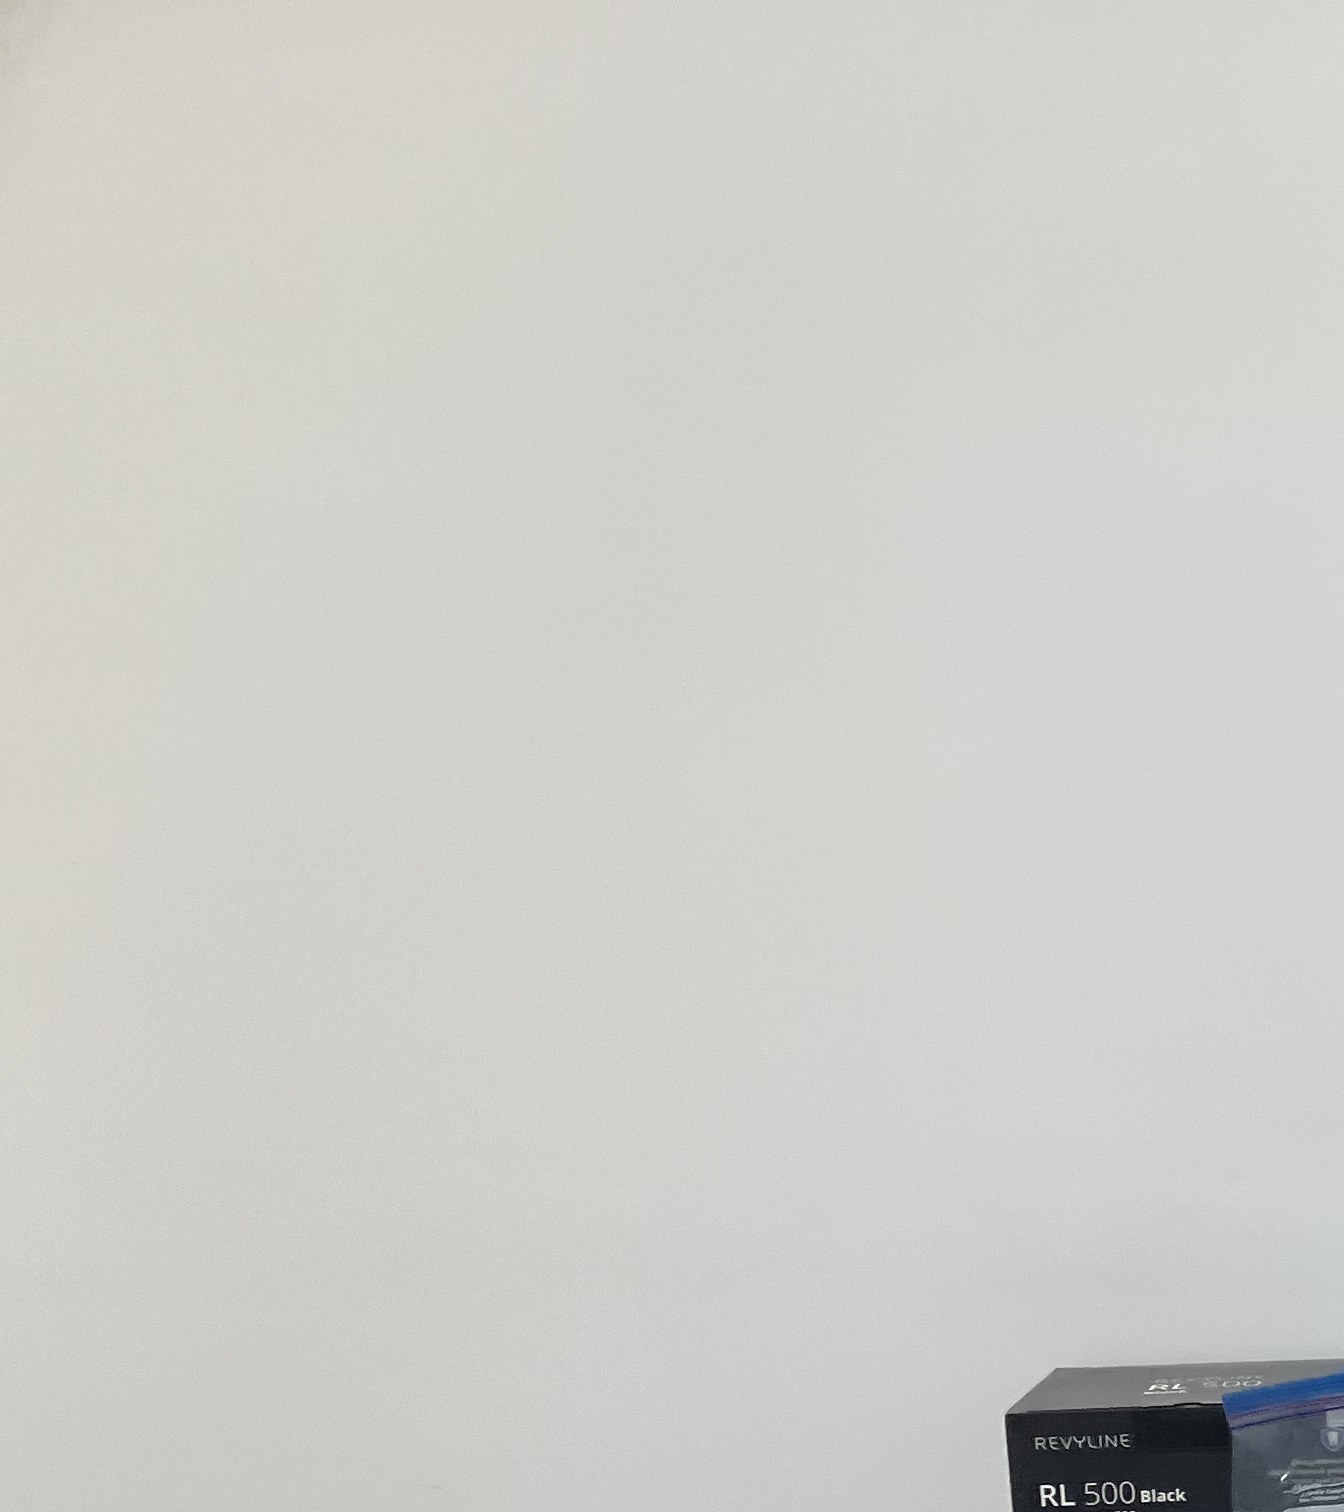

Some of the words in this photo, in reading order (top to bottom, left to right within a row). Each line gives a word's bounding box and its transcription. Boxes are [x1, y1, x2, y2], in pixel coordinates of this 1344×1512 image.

[1034, 1433, 1131, 1451] REVYLINE
[1039, 1483, 1076, 1508] RL
[1083, 1480, 1137, 1506] 500
[1140, 1488, 1187, 1504] Black
